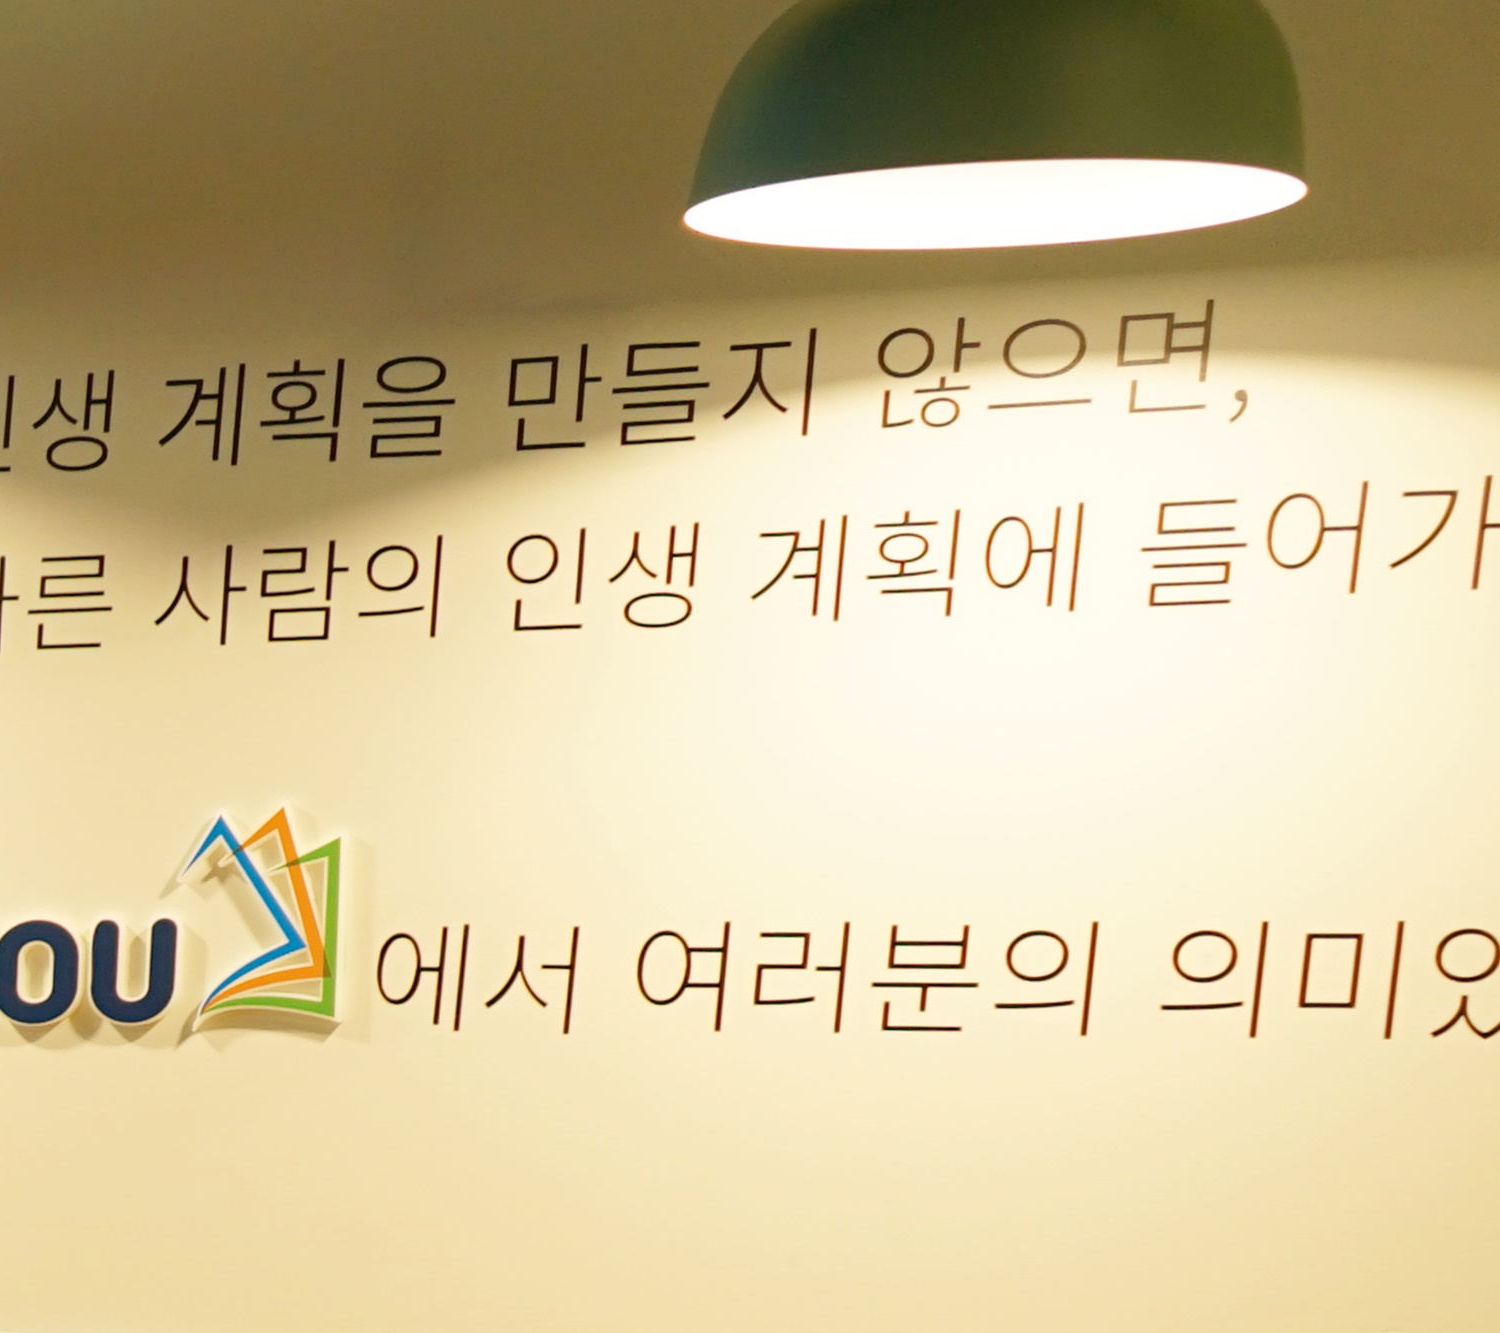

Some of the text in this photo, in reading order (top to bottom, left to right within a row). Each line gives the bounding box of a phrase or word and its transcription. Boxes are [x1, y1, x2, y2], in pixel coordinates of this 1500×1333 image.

[157, 355, 457, 468] 계획을
[506, 326, 820, 453] 만들지
[877, 299, 1250, 429] 않으면,
[152, 533, 444, 648] 사람의
[505, 520, 701, 633] 인생
[749, 501, 1086, 623] 계획에
[1140, 474, 1500, 607] 들어가
[375, 922, 581, 1036] 에서
[635, 920, 1101, 1038] 여러분의
